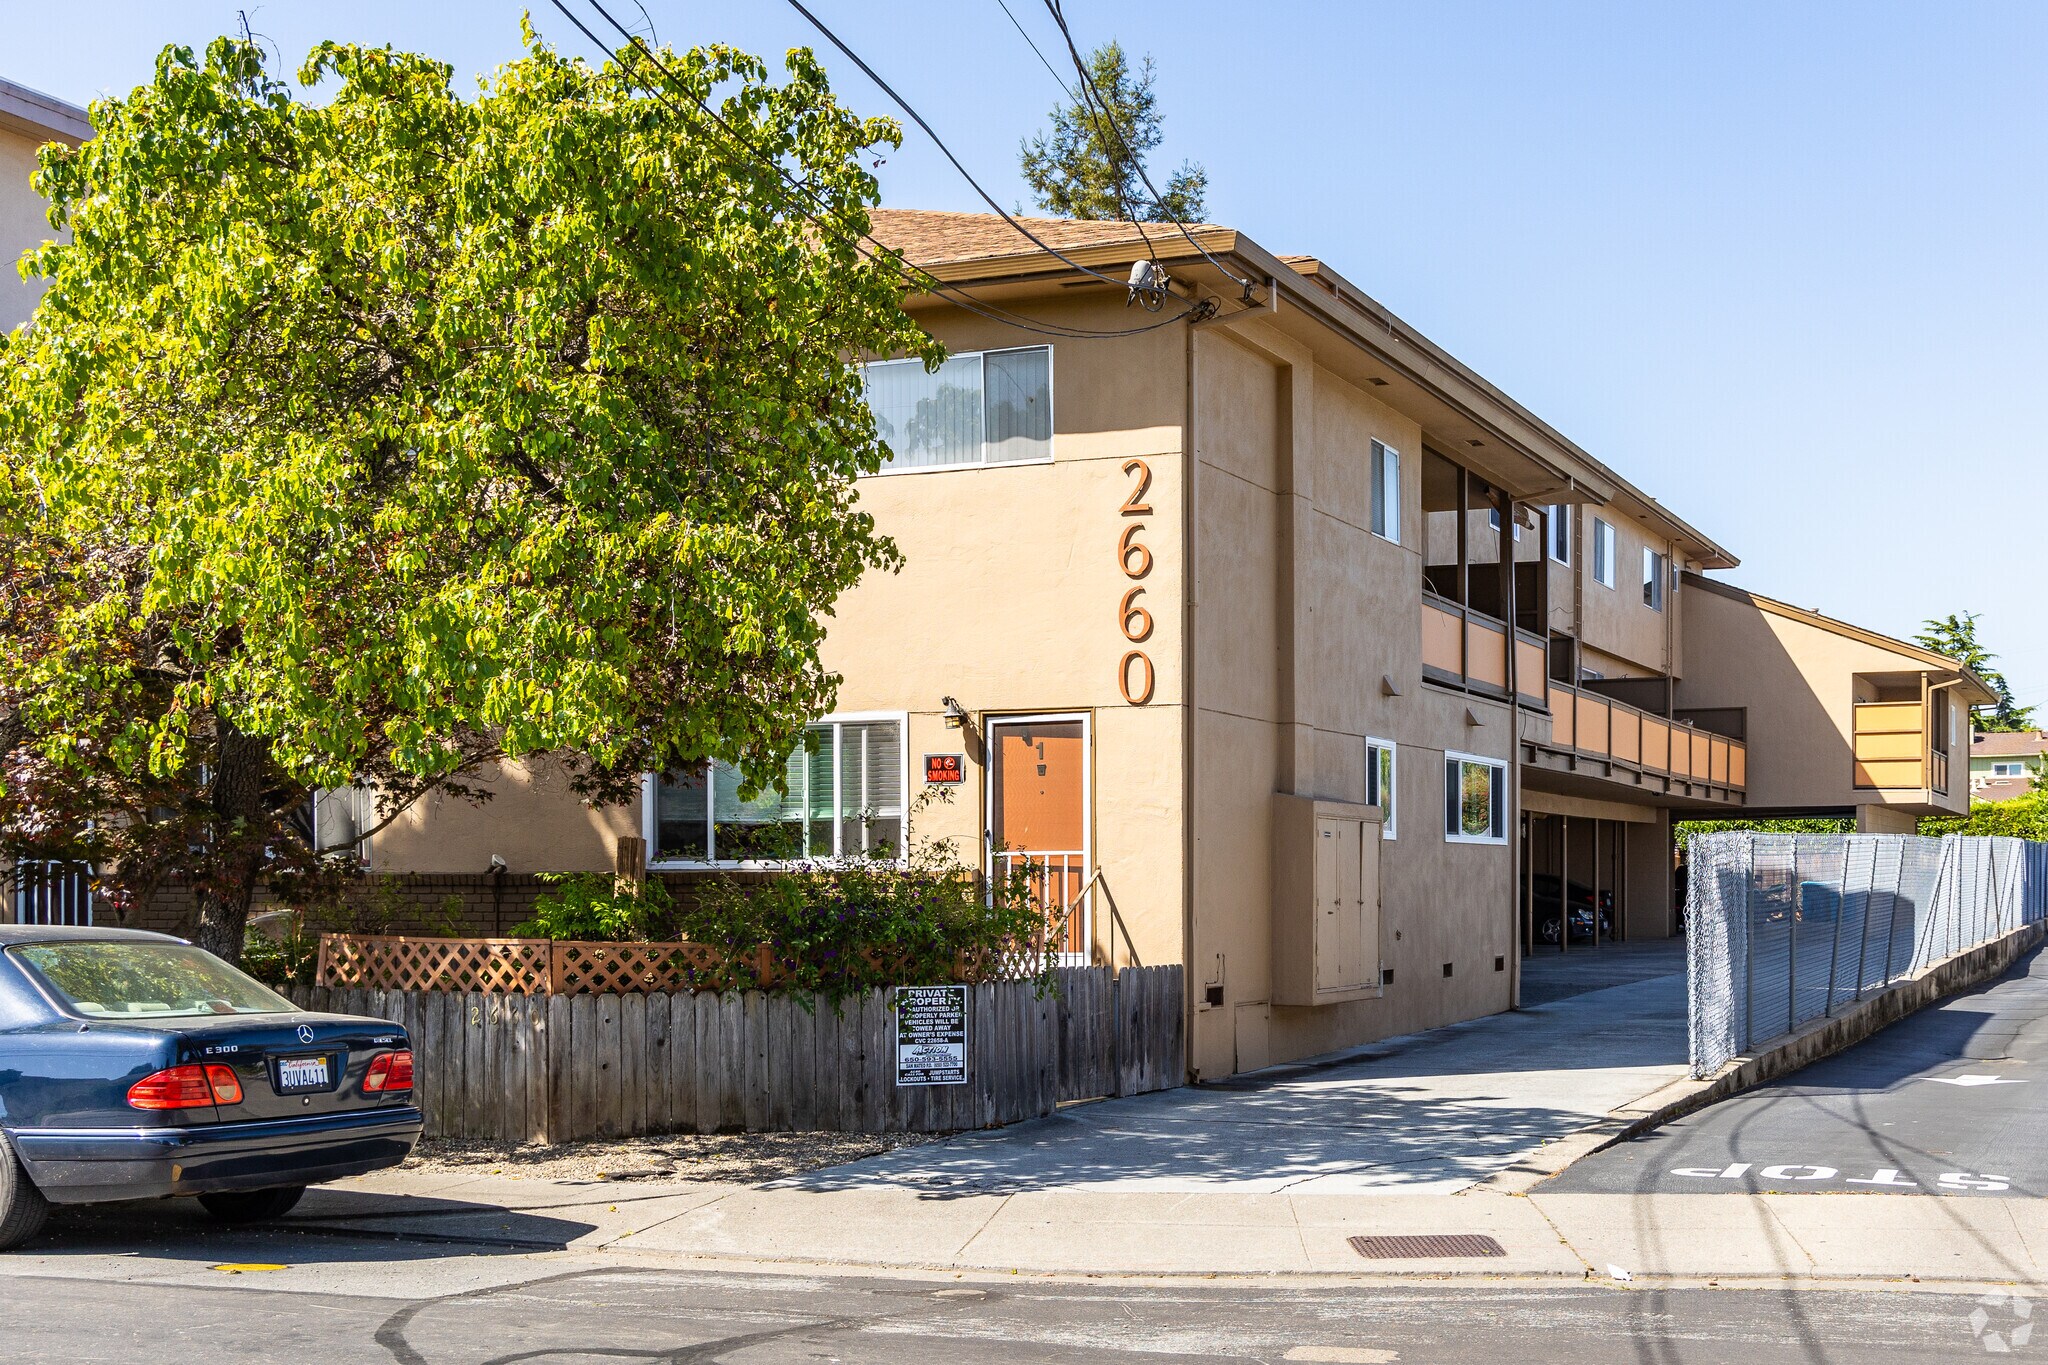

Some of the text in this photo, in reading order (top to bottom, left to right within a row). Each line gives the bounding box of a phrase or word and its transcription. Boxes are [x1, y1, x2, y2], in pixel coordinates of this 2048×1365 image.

[1118, 458, 1151, 704] 2660
[1036, 742, 1043, 760] 1
[931, 757, 942, 769] NO
[927, 770, 960, 781] SMOKING
[901, 997, 963, 1006] ROPERT
[215, 1045, 239, 1053] 300
[287, 1060, 319, 1069] California
[282, 1068, 327, 1087] 3UVA411
[1670, 1162, 2011, 1191] STOP
